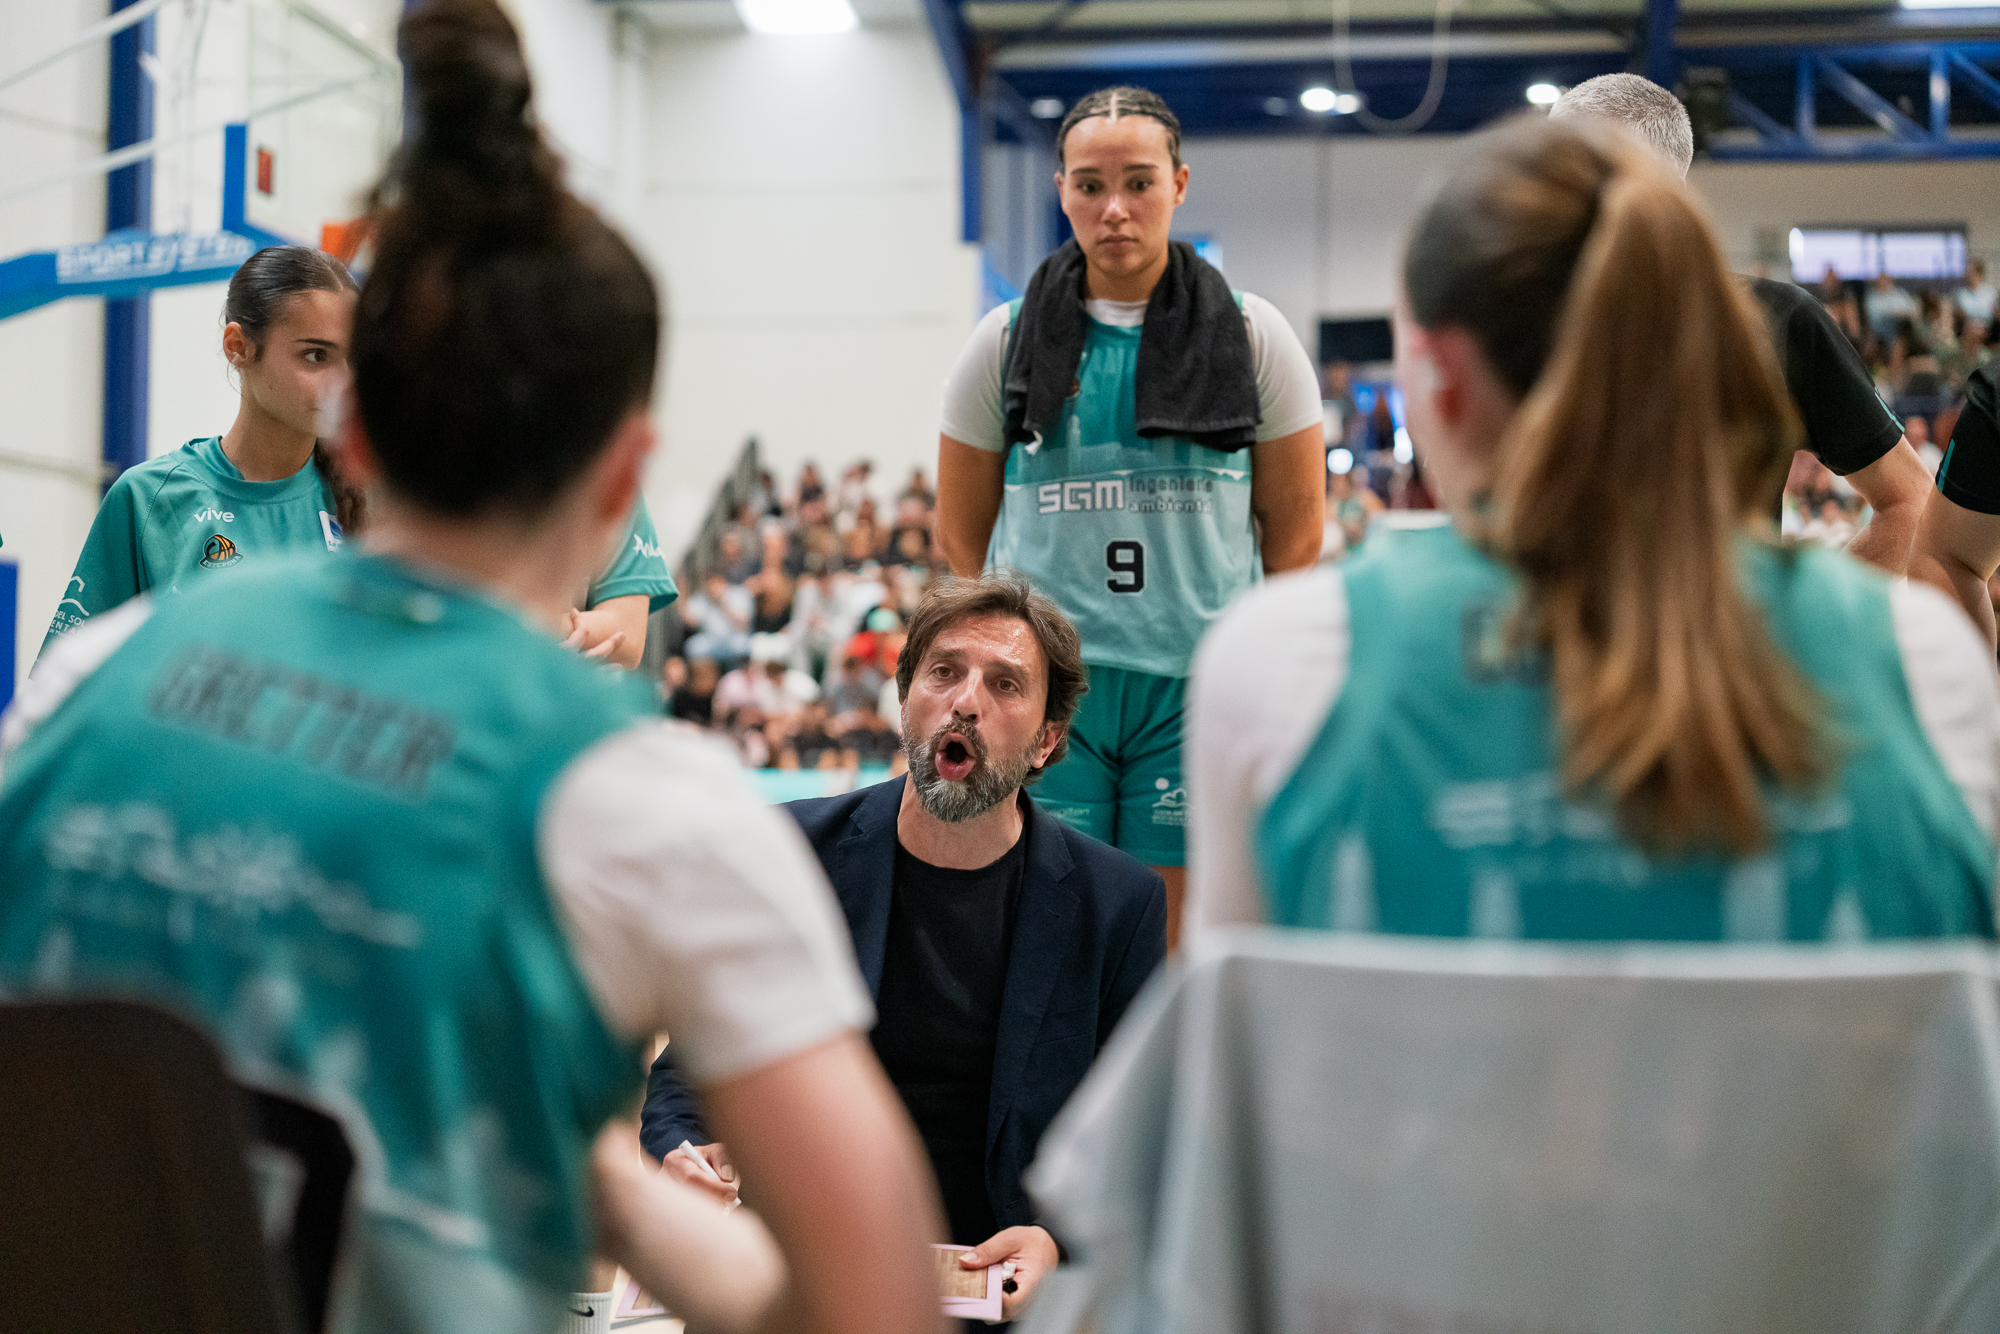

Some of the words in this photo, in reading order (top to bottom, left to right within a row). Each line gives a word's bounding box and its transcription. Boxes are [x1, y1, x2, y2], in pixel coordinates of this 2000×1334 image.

[193, 507, 235, 523] vive
[1038, 478, 1125, 515] SGM
[1105, 539, 1146, 594] 9
